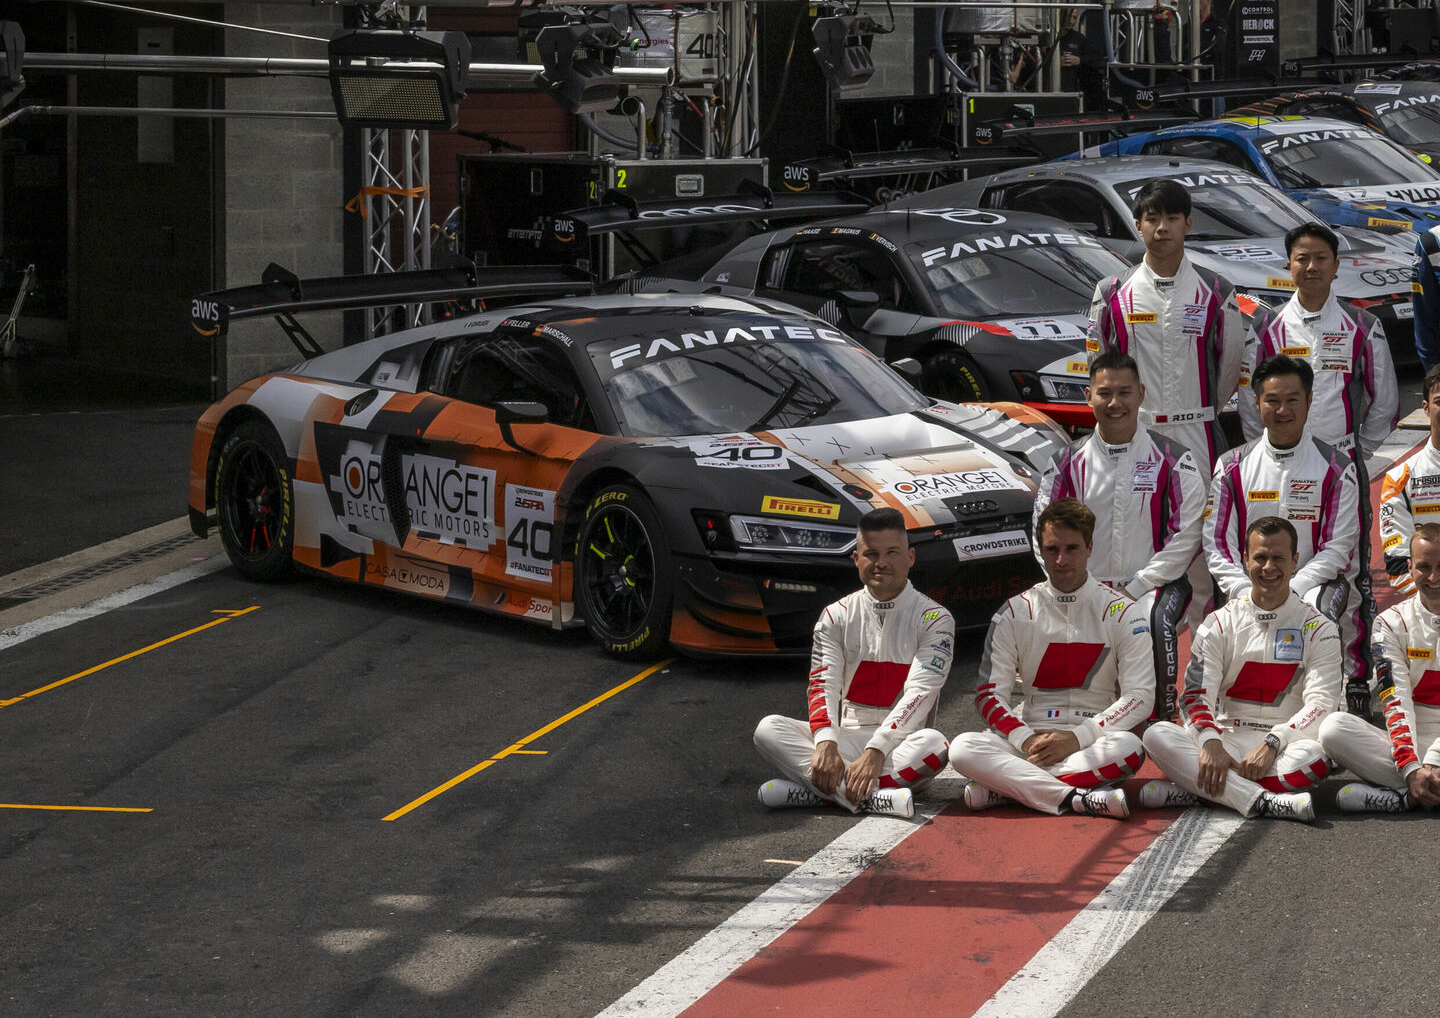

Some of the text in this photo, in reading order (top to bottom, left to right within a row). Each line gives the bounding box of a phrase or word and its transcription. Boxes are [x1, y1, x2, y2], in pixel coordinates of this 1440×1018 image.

[636, 38, 670, 47] nergies
[686, 33, 714, 59] 40
[1136, 89, 1154, 102] aws
[968, 98, 975, 114] 1
[975, 127, 992, 138] aws
[1261, 130, 1384, 155] FANATEC
[617, 169, 627, 188] 2
[784, 165, 810, 181] aws
[875, 235, 898, 253] VERVISCH
[922, 232, 1102, 268] FANATEC
[1221, 246, 1273, 260] 25
[192, 299, 220, 322] aws
[1129, 314, 1156, 323] PIRELLI
[509, 319, 530, 329] FELLER
[1021, 323, 1062, 336] 11
[542, 325, 574, 348] MARSCHALL
[609, 324, 847, 370] FANATEC
[1281, 348, 1309, 357] PIRELLI
[698, 446, 783, 462] 40
[342, 455, 489, 521] ORANGE1
[894, 471, 1008, 495] ORANGE1
[905, 482, 1015, 501] ELECTRIC MOTORS
[1250, 492, 1278, 501] PIRELLI
[768, 498, 833, 516] PIRELLI
[434, 511, 490, 540] MOTORS
[507, 517, 555, 561] 40
[962, 537, 1028, 553] CROWDSTRIKE
[365, 562, 446, 592] CASA MODA
[528, 598, 553, 615] Spor
[1110, 601, 1125, 617] P1
[1408, 649, 1431, 658] PIRELLI
[906, 694, 923, 712] Sport
[1118, 697, 1137, 713] Sport
